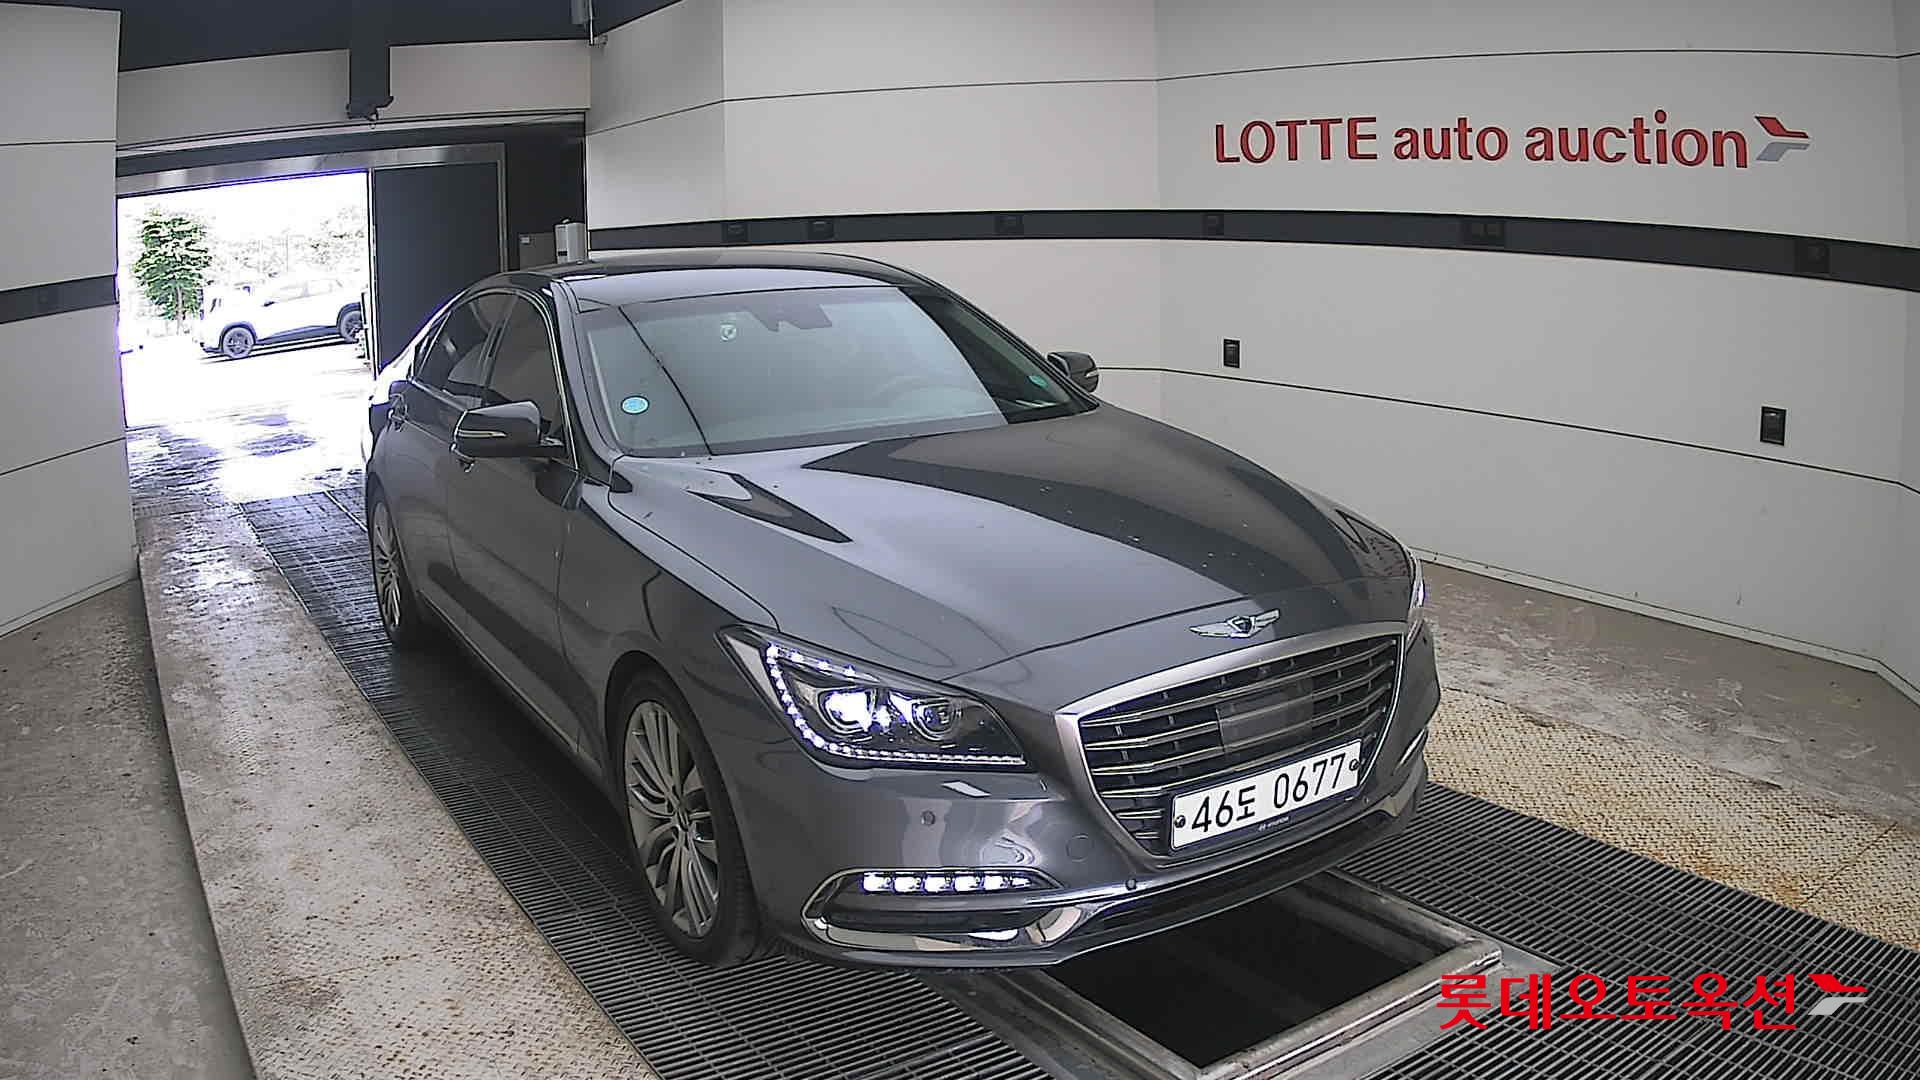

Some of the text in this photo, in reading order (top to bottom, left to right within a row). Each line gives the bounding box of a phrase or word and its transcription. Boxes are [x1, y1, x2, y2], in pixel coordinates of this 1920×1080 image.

[1214, 109, 1748, 168] LOTTE auto auction
[1191, 753, 1346, 833] 46도 0677
